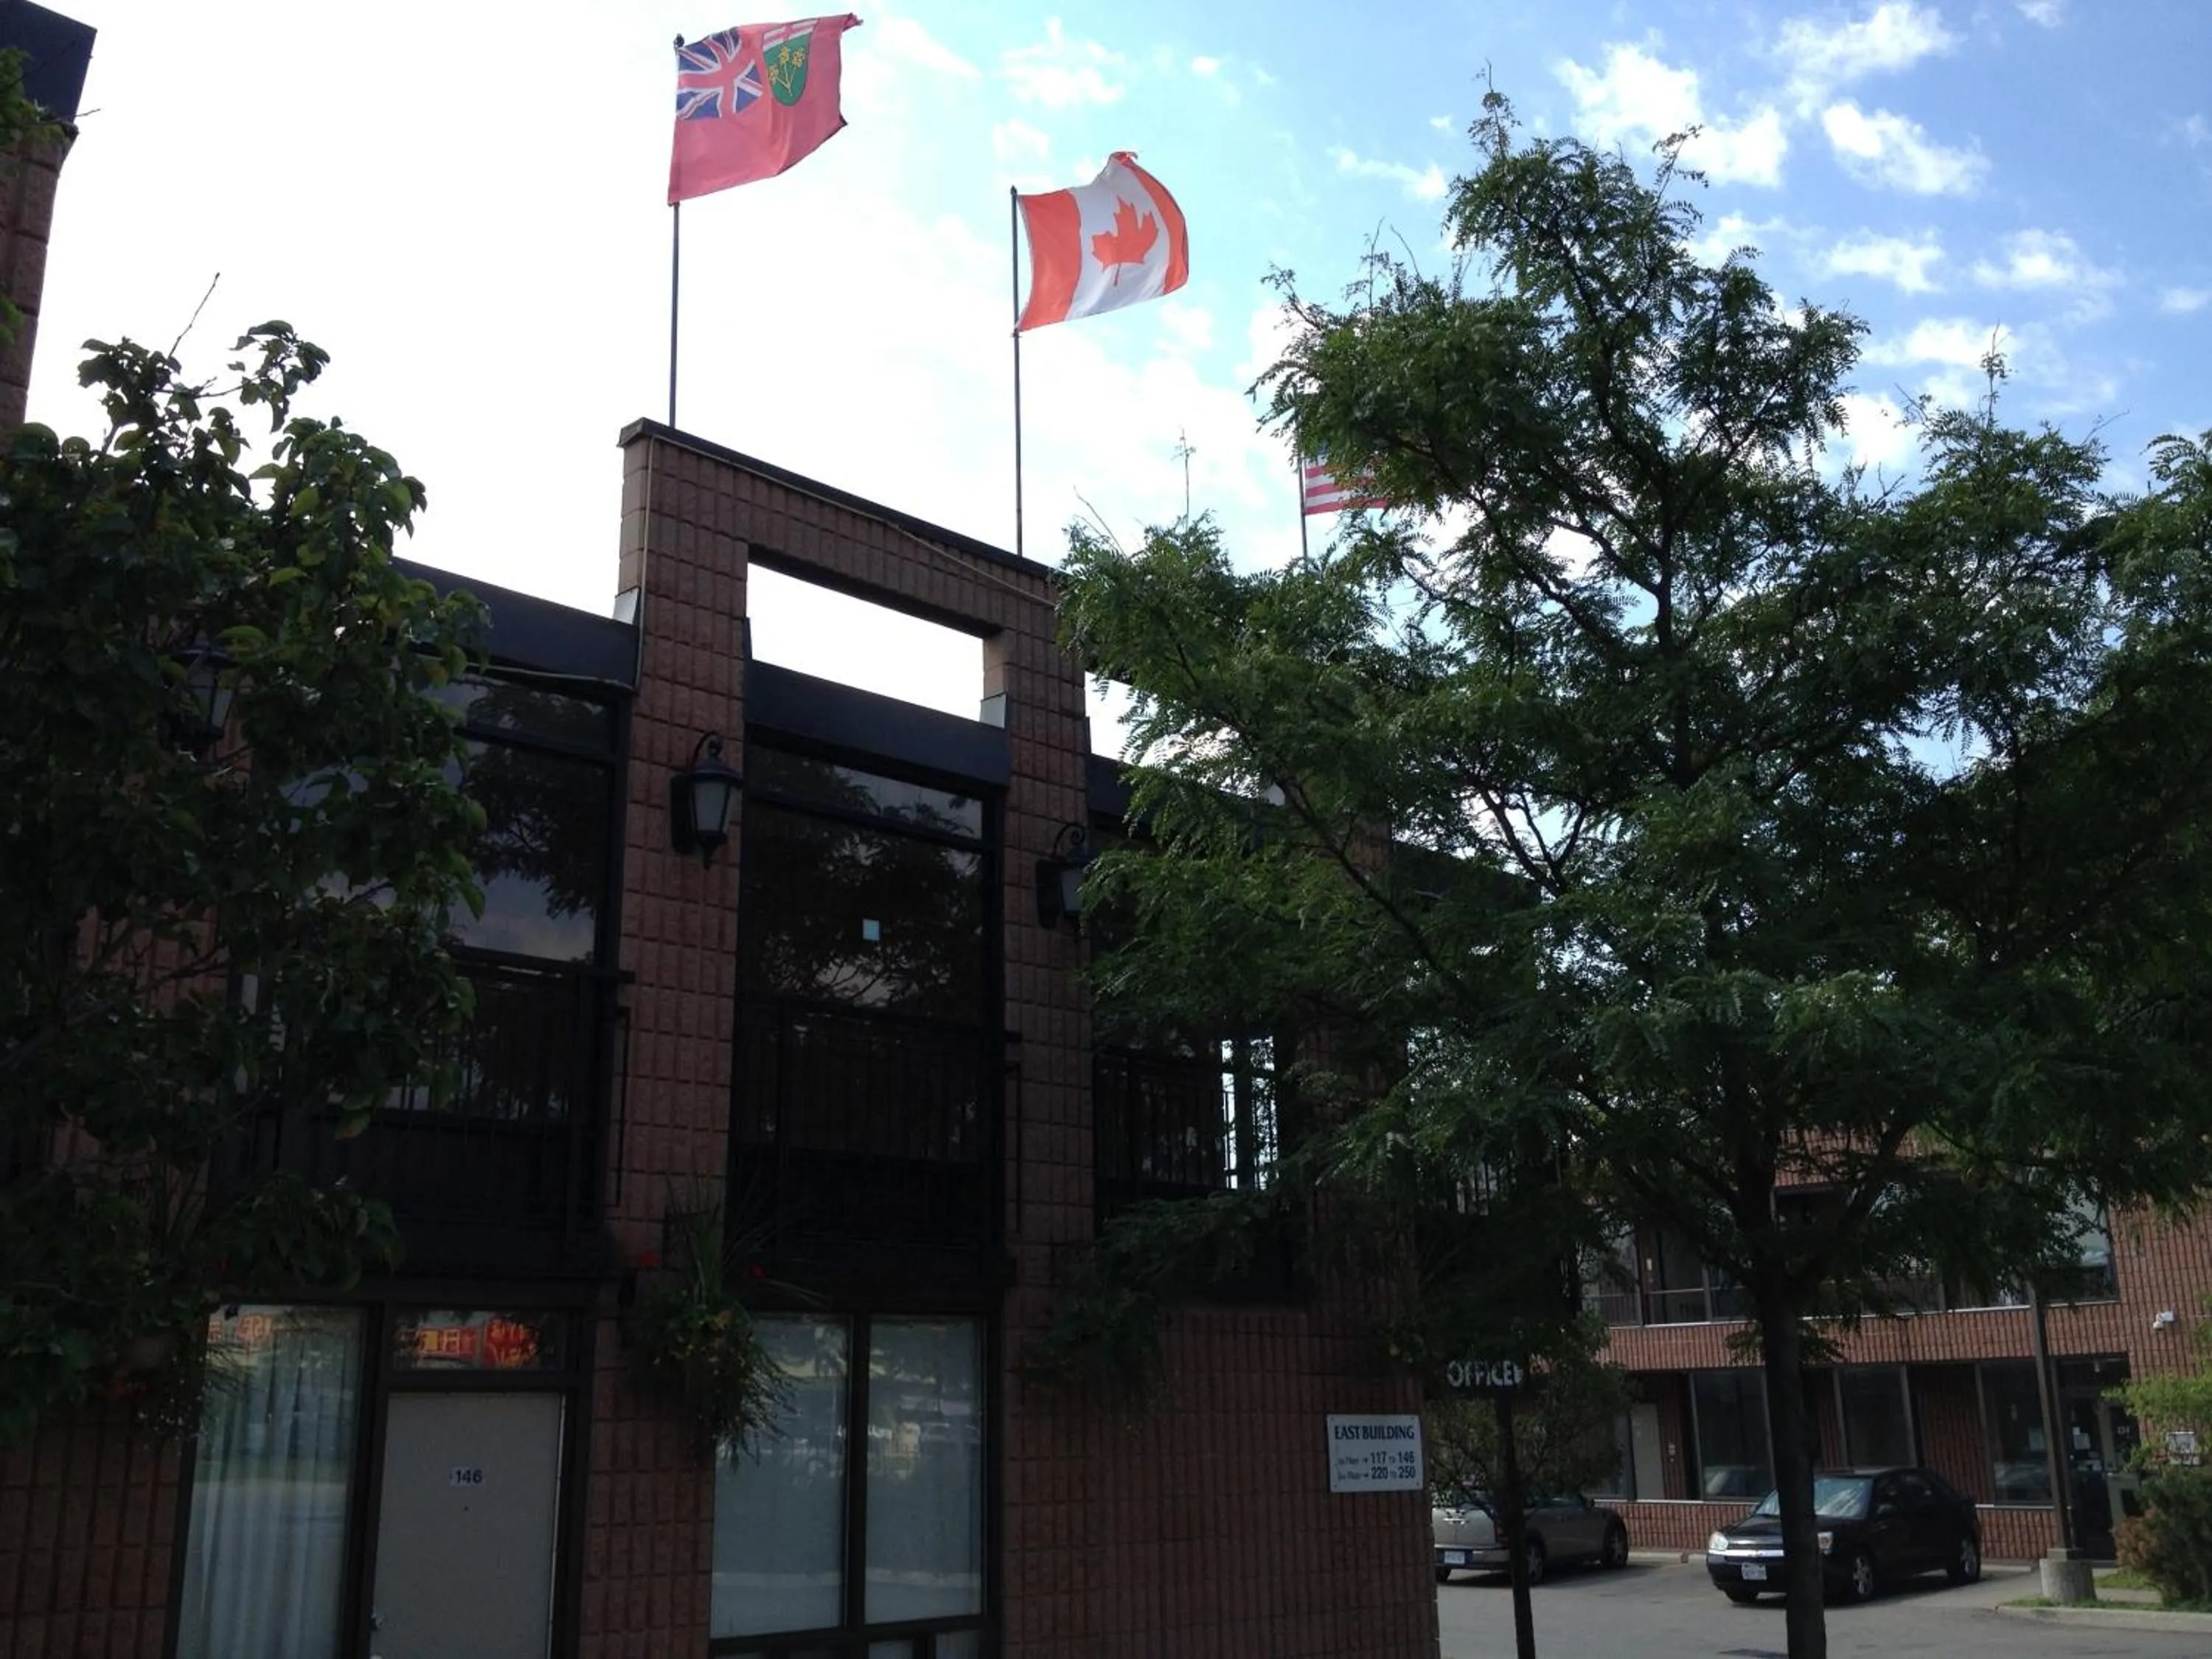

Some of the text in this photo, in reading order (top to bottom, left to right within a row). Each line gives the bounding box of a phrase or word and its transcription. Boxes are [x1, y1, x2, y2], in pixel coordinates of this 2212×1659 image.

[1446, 1360, 1513, 1388] OFFICE
[1334, 1425, 1415, 1440] EAST BUILDING
[1370, 1451, 1386, 1464] 117
[456, 1469, 482, 1484] 146
[1398, 1465, 1416, 1479] 250
